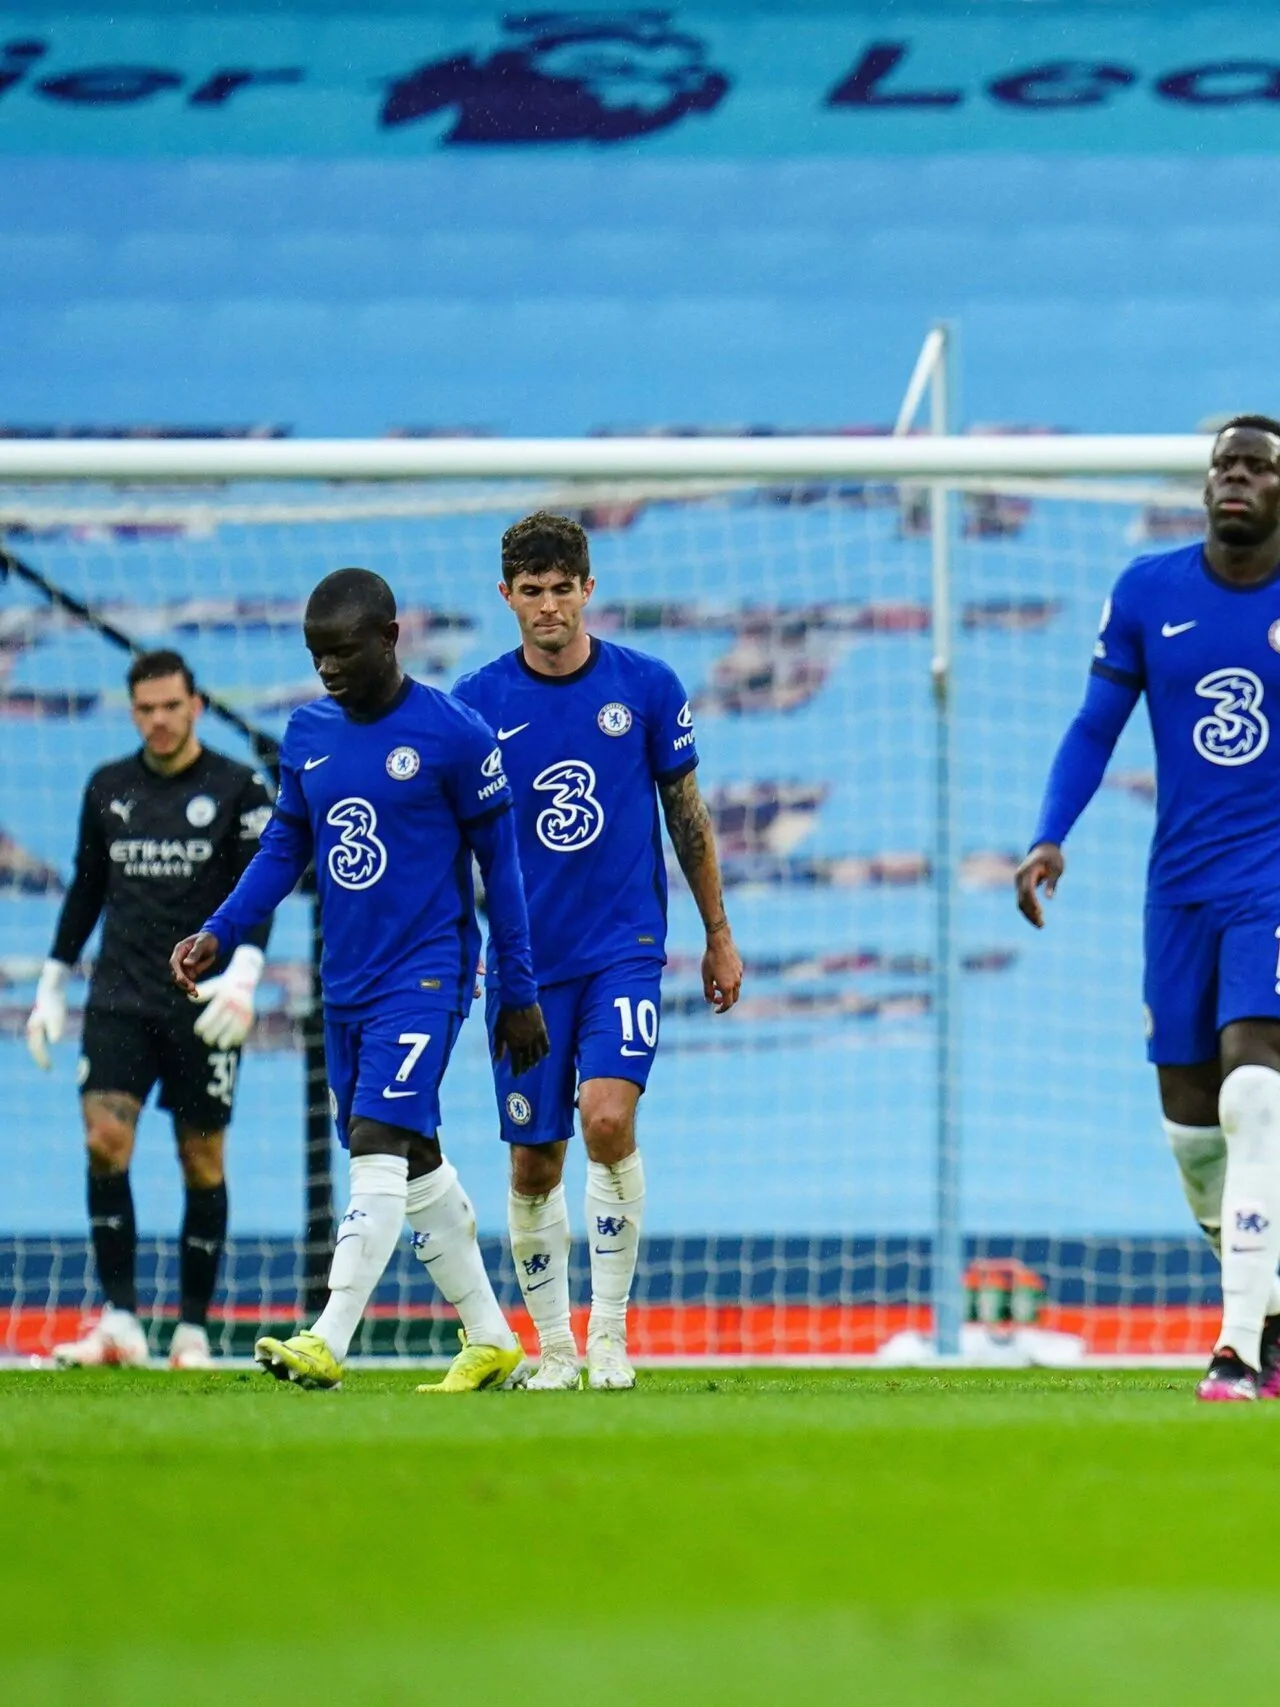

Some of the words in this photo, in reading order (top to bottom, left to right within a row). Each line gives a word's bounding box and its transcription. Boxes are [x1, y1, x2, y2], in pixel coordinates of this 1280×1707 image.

[1192, 667, 1269, 766] 3
[532, 759, 605, 852] 3
[109, 839, 213, 862] ETIHAD
[326, 797, 387, 891] 3
[396, 1032, 432, 1082] 7
[613, 996, 658, 1048] 10
